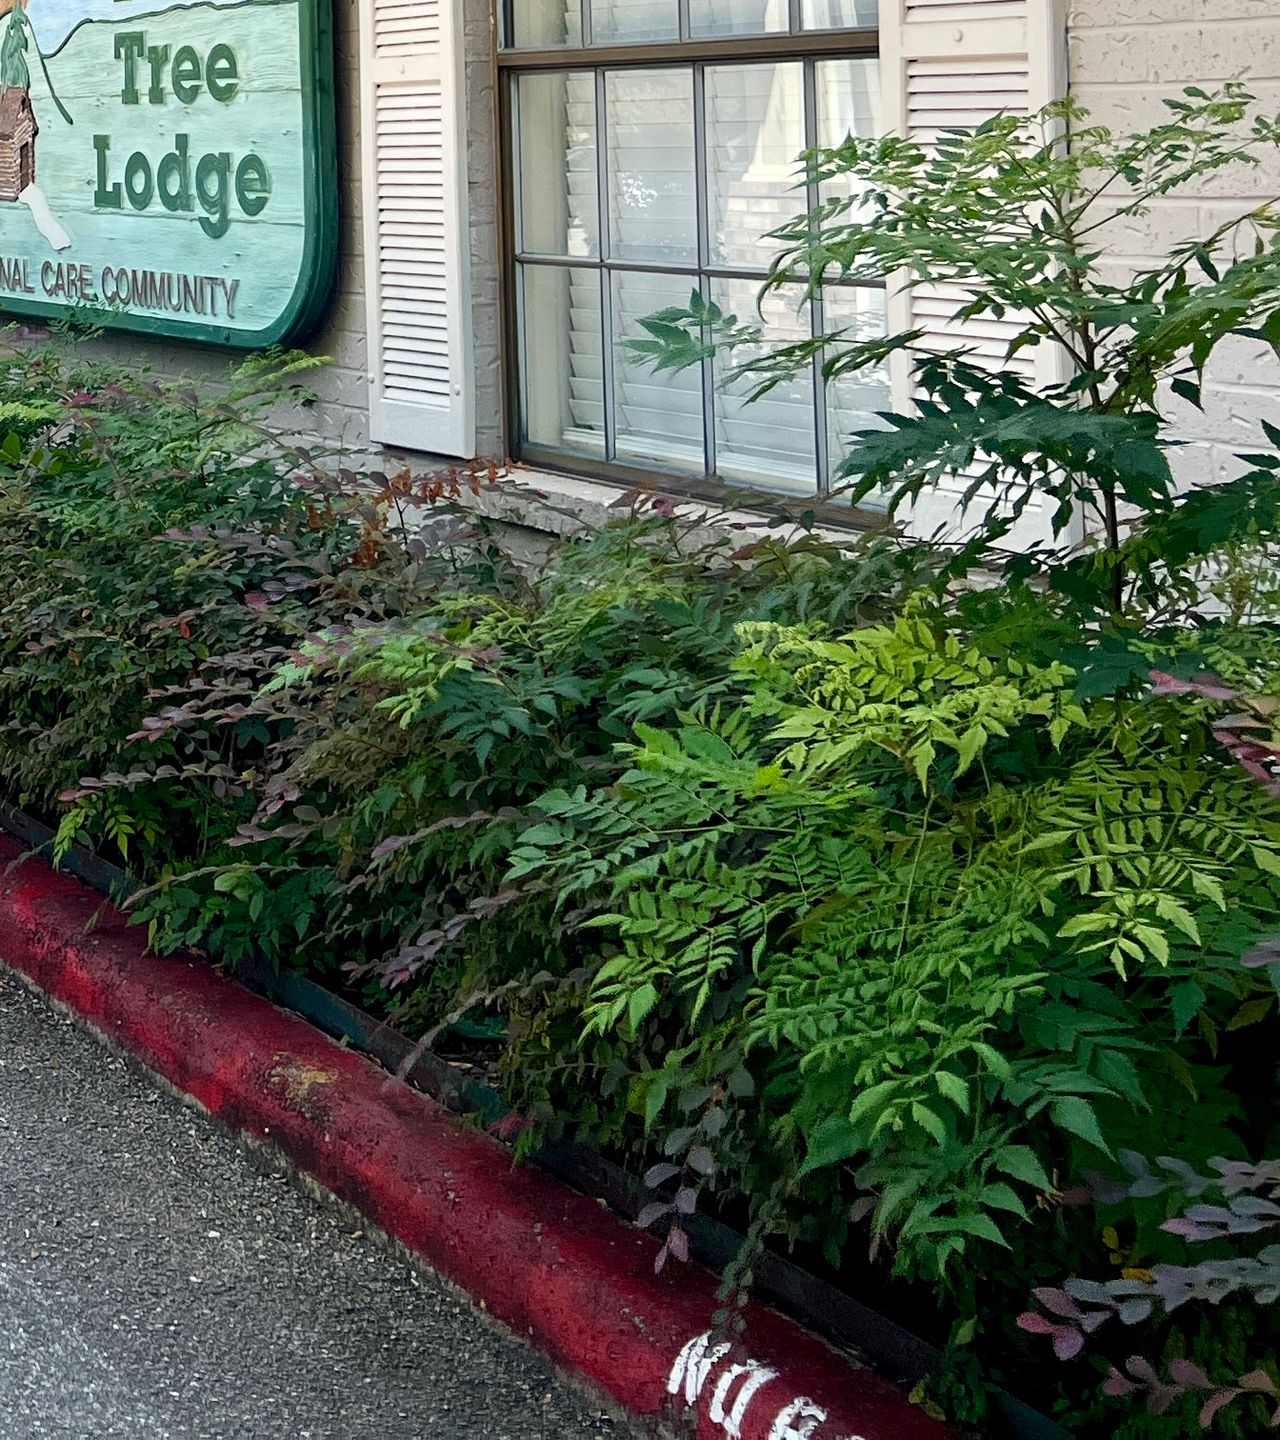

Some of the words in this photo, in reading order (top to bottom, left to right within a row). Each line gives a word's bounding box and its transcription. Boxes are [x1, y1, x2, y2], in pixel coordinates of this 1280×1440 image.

[114, 32, 238, 105] Tree
[93, 133, 271, 239] Lodge
[41, 260, 94, 300] CARE
[103, 266, 240, 319] COMMUNITY
